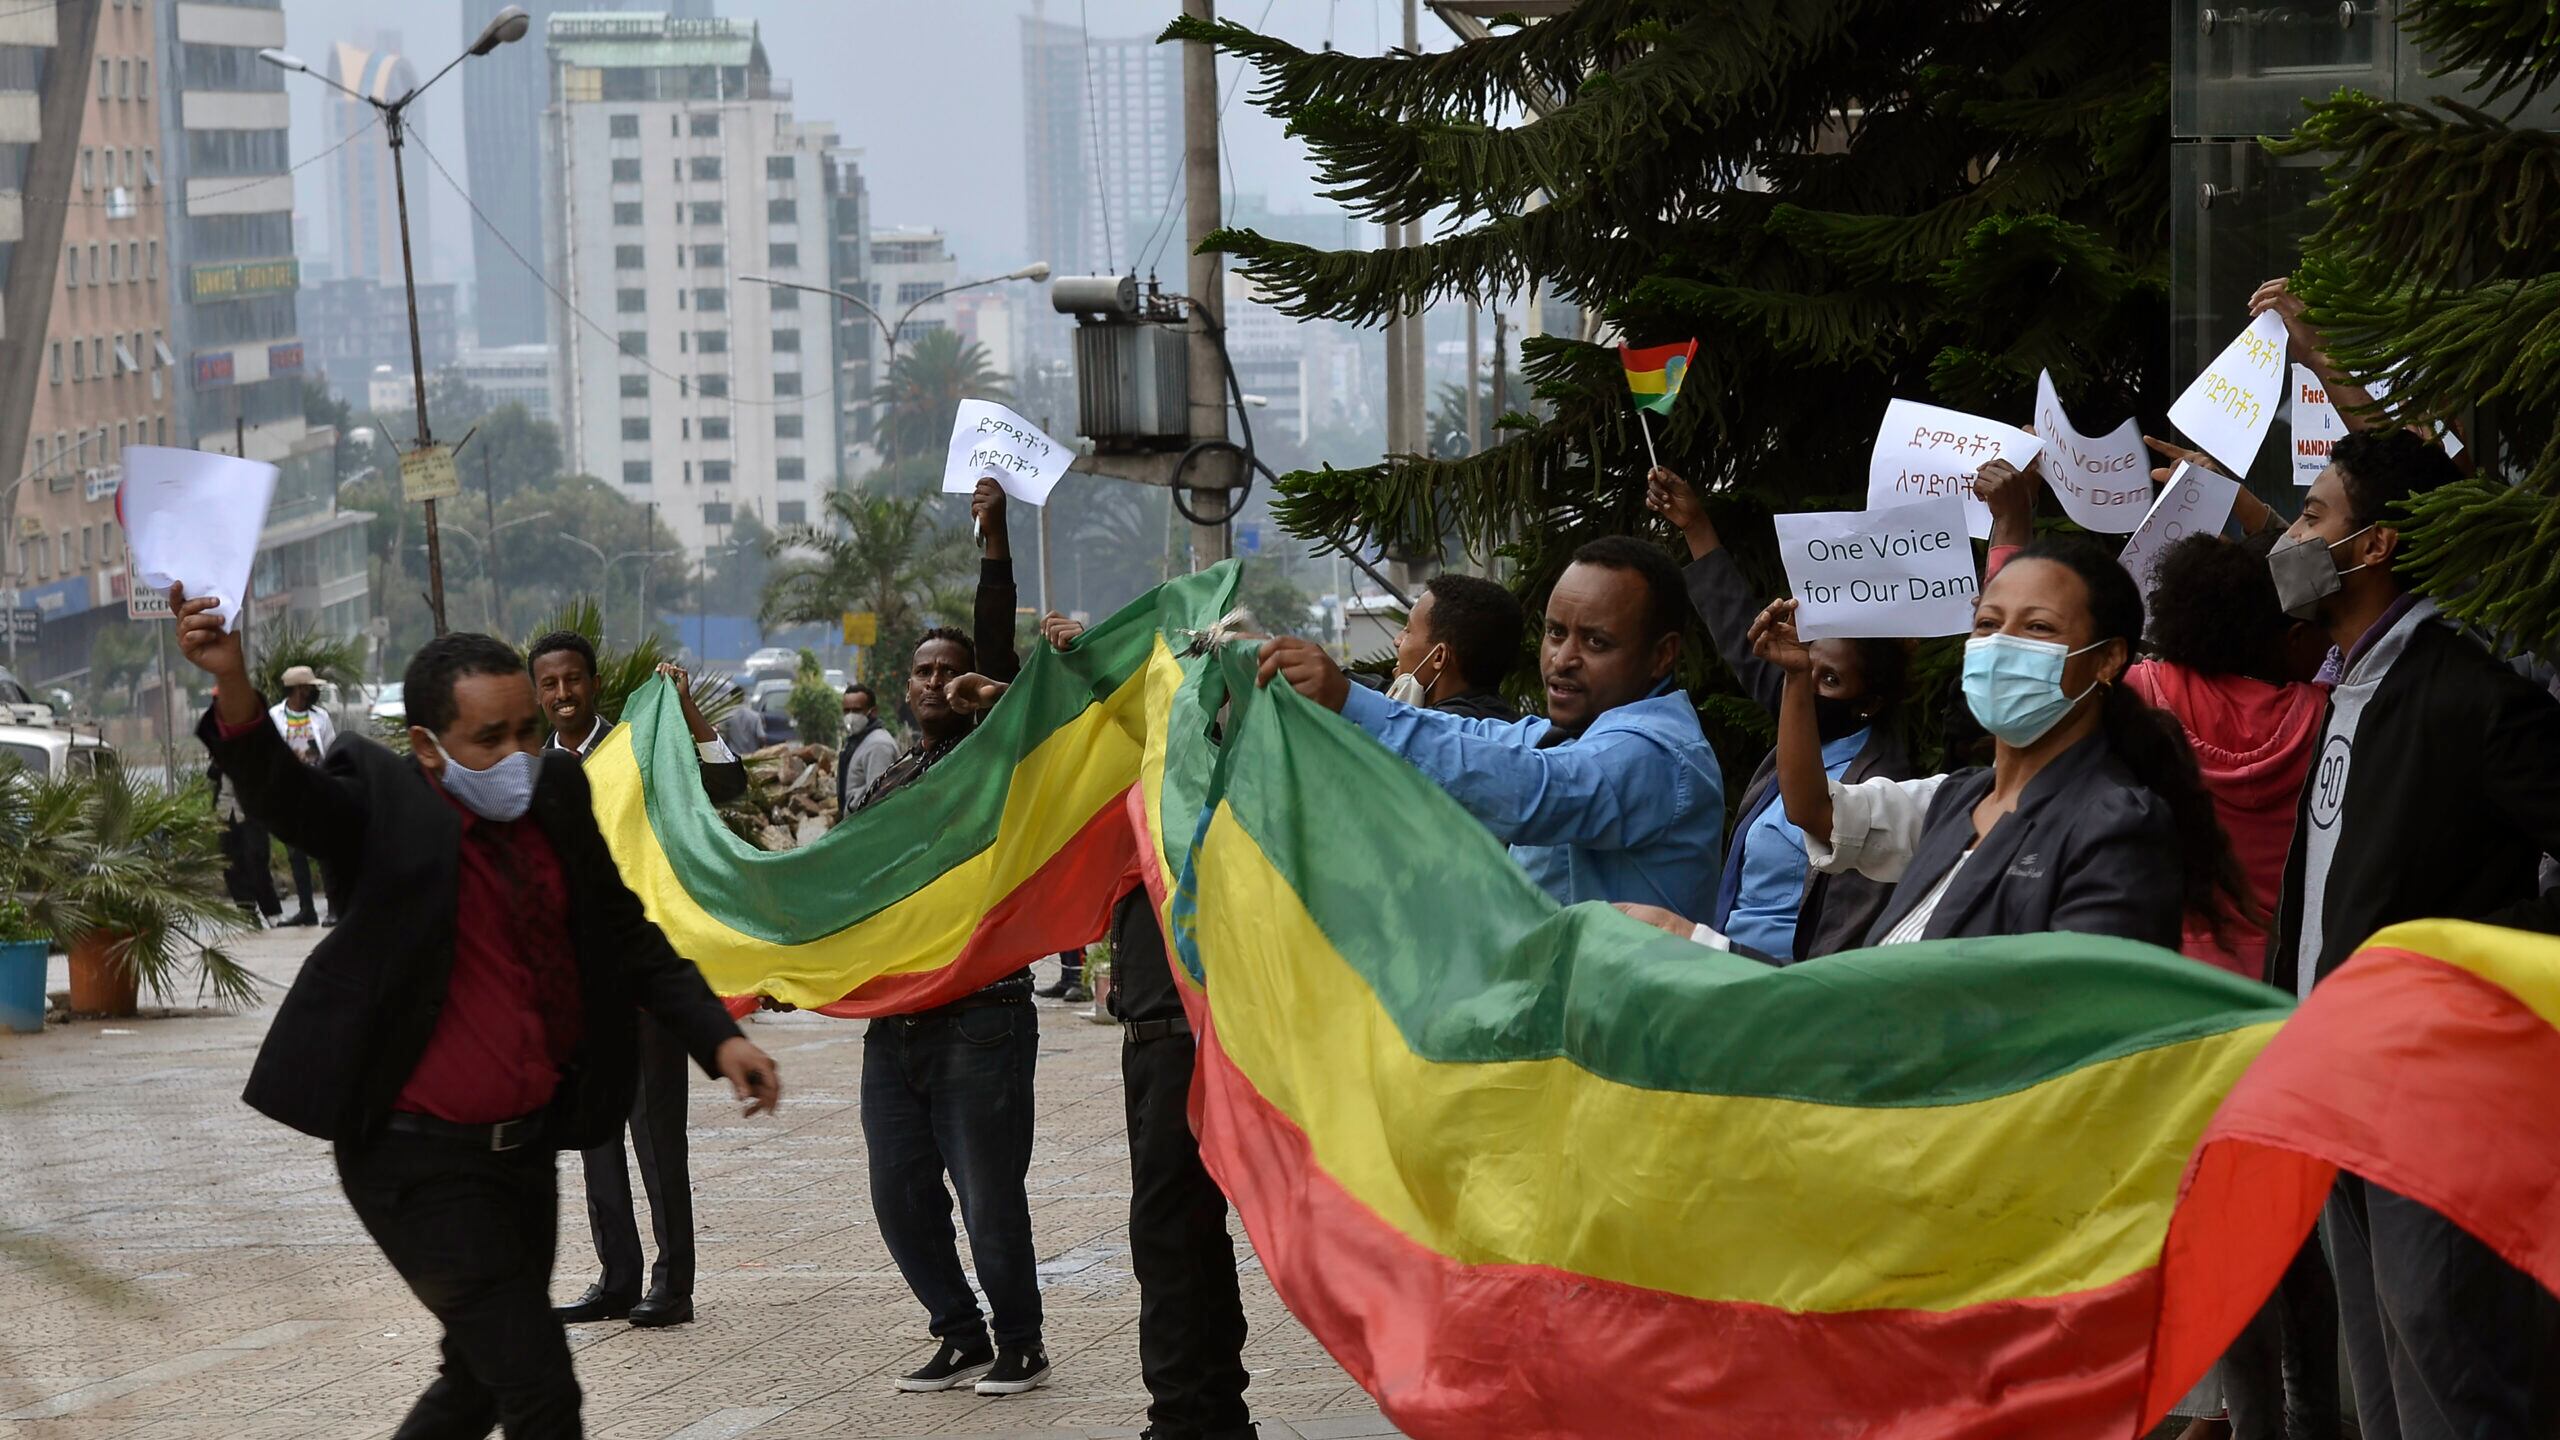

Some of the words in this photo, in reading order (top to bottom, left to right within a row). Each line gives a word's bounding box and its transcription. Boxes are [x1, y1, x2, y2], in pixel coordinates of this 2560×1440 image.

[2301, 384, 2325, 403] Face
[2324, 413, 2331, 429] Is
[2044, 408, 2067, 454] One
[2072, 446, 2136, 474] Voice
[2052, 460, 2084, 498] Our
[2090, 486, 2150, 506] Dam
[1807, 539, 1863, 562] One
[1869, 529, 1951, 559] Voice
[1804, 580, 1841, 604] for
[1850, 579, 1900, 603] Our
[1908, 575, 1976, 601] Dam
[2320, 755, 2344, 810] 90
